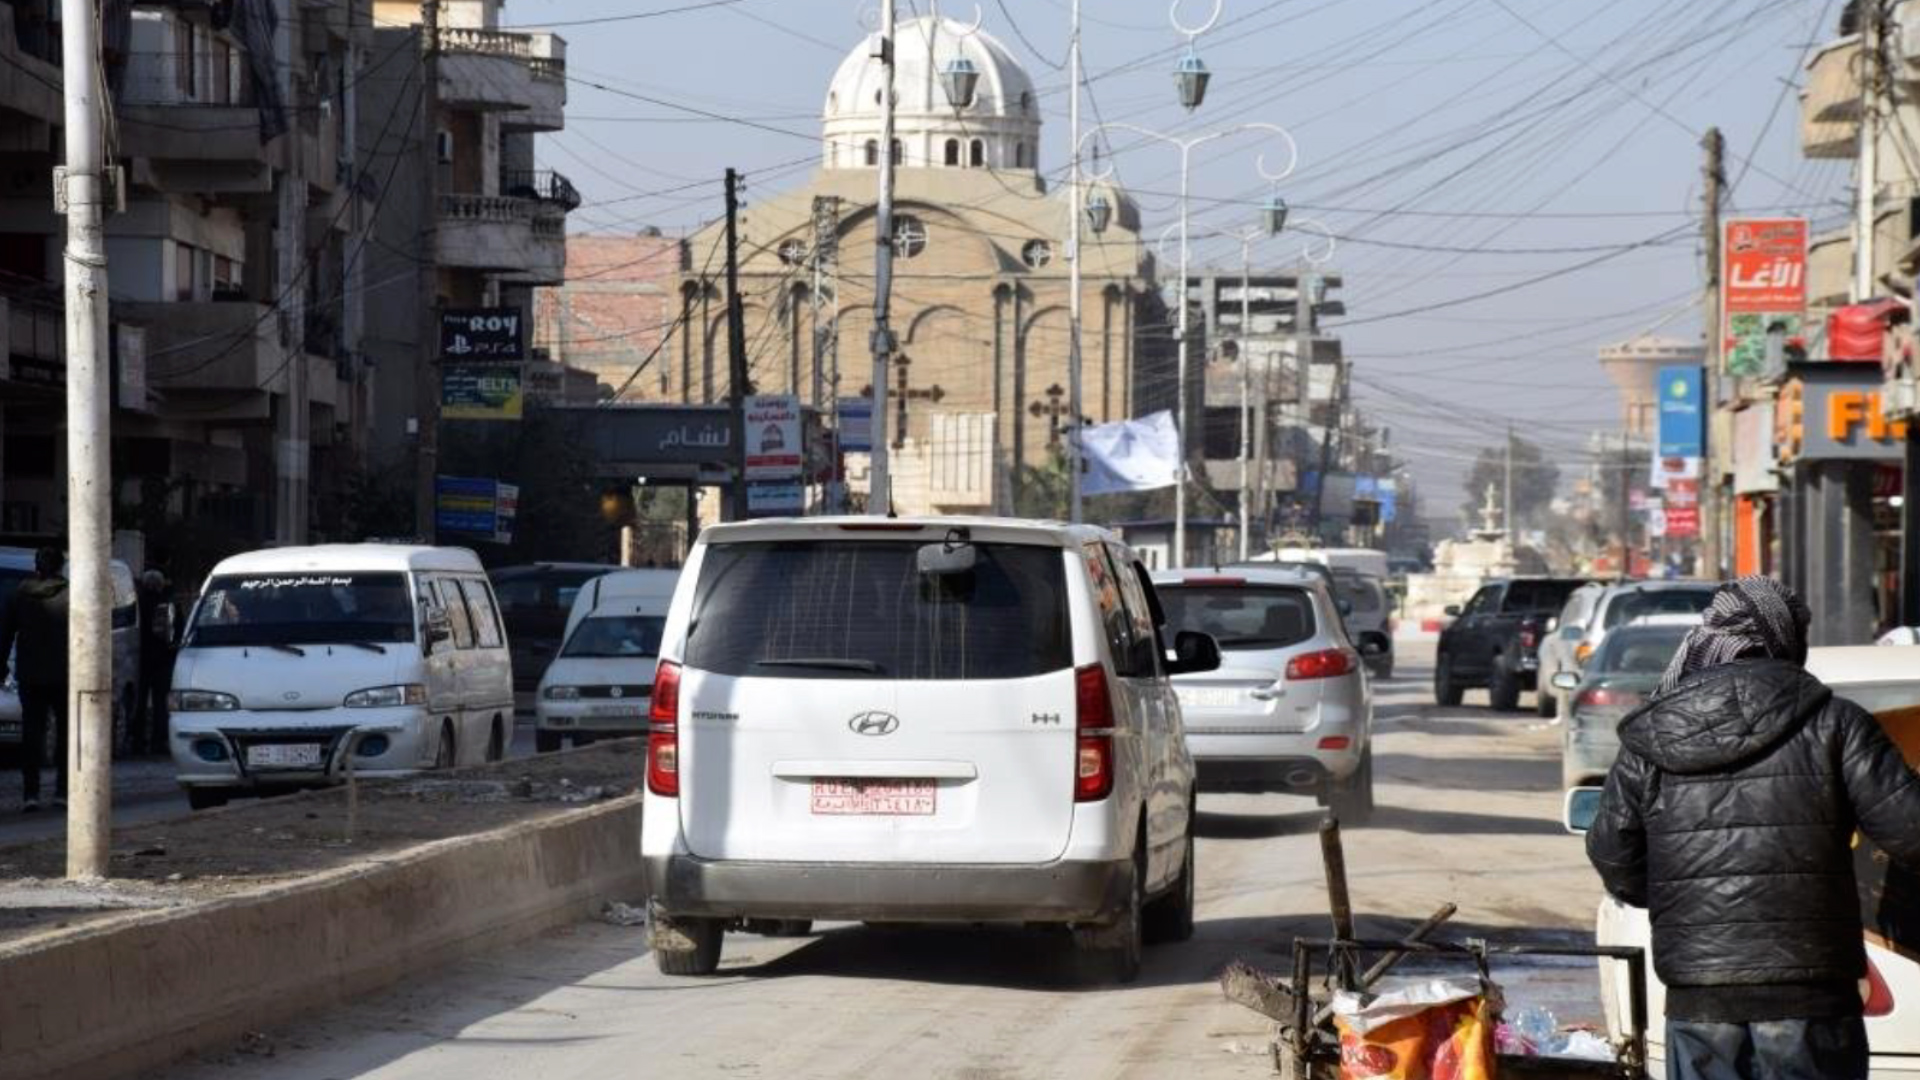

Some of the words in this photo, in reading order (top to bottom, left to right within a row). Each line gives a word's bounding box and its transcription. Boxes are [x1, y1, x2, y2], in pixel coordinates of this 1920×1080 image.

[1730, 256, 1803, 288] الآغا
[470, 315, 518, 337] ROY
[474, 341, 517, 353] PS4
[659, 424, 731, 450] لشام
